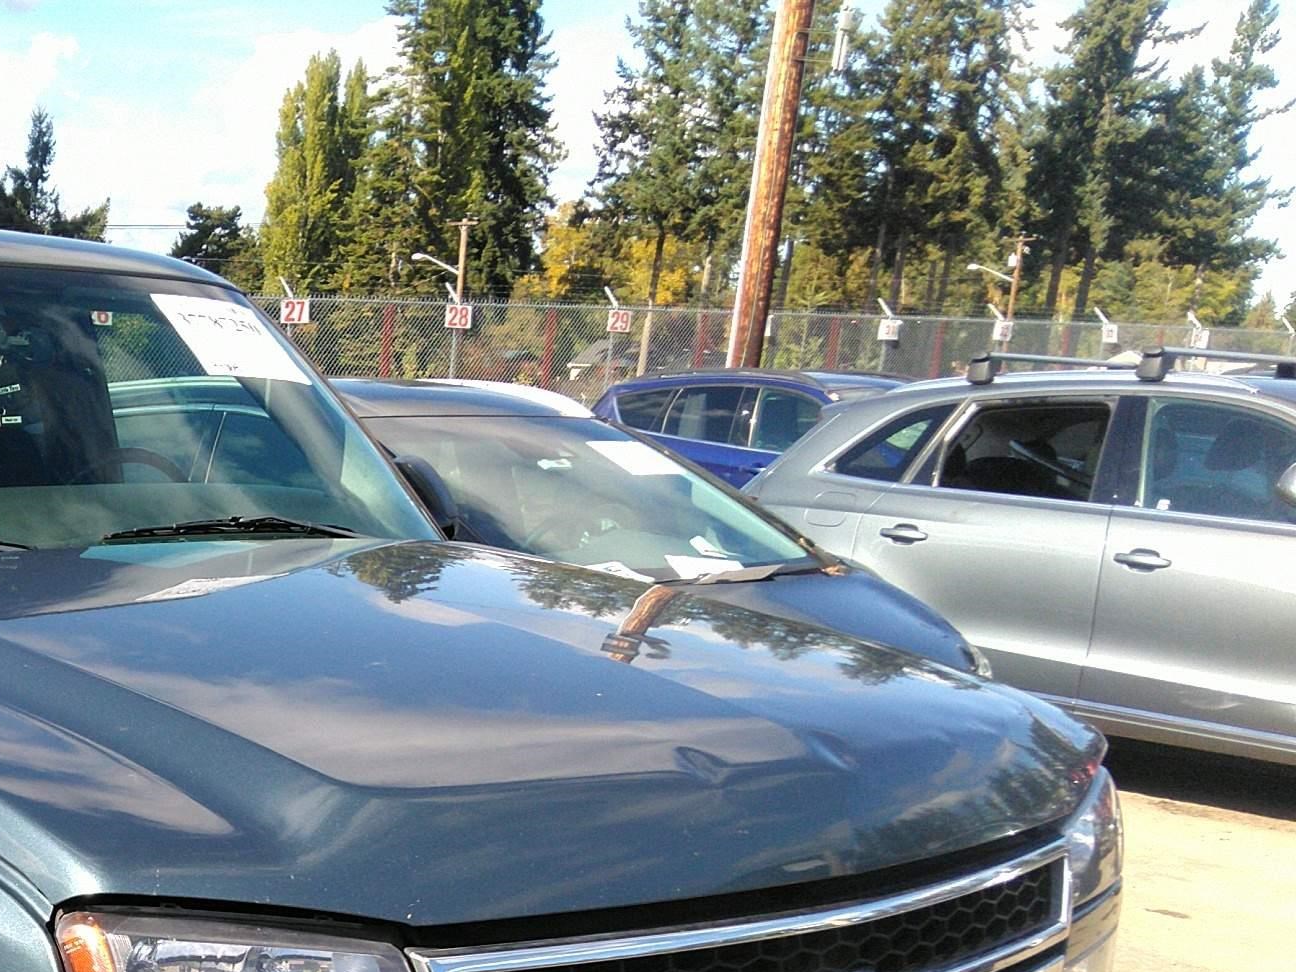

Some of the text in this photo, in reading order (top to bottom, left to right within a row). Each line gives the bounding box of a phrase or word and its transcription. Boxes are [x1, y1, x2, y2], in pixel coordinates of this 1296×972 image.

[284, 300, 305, 322] 27
[447, 306, 469, 327] 28
[609, 311, 630, 331] 29
